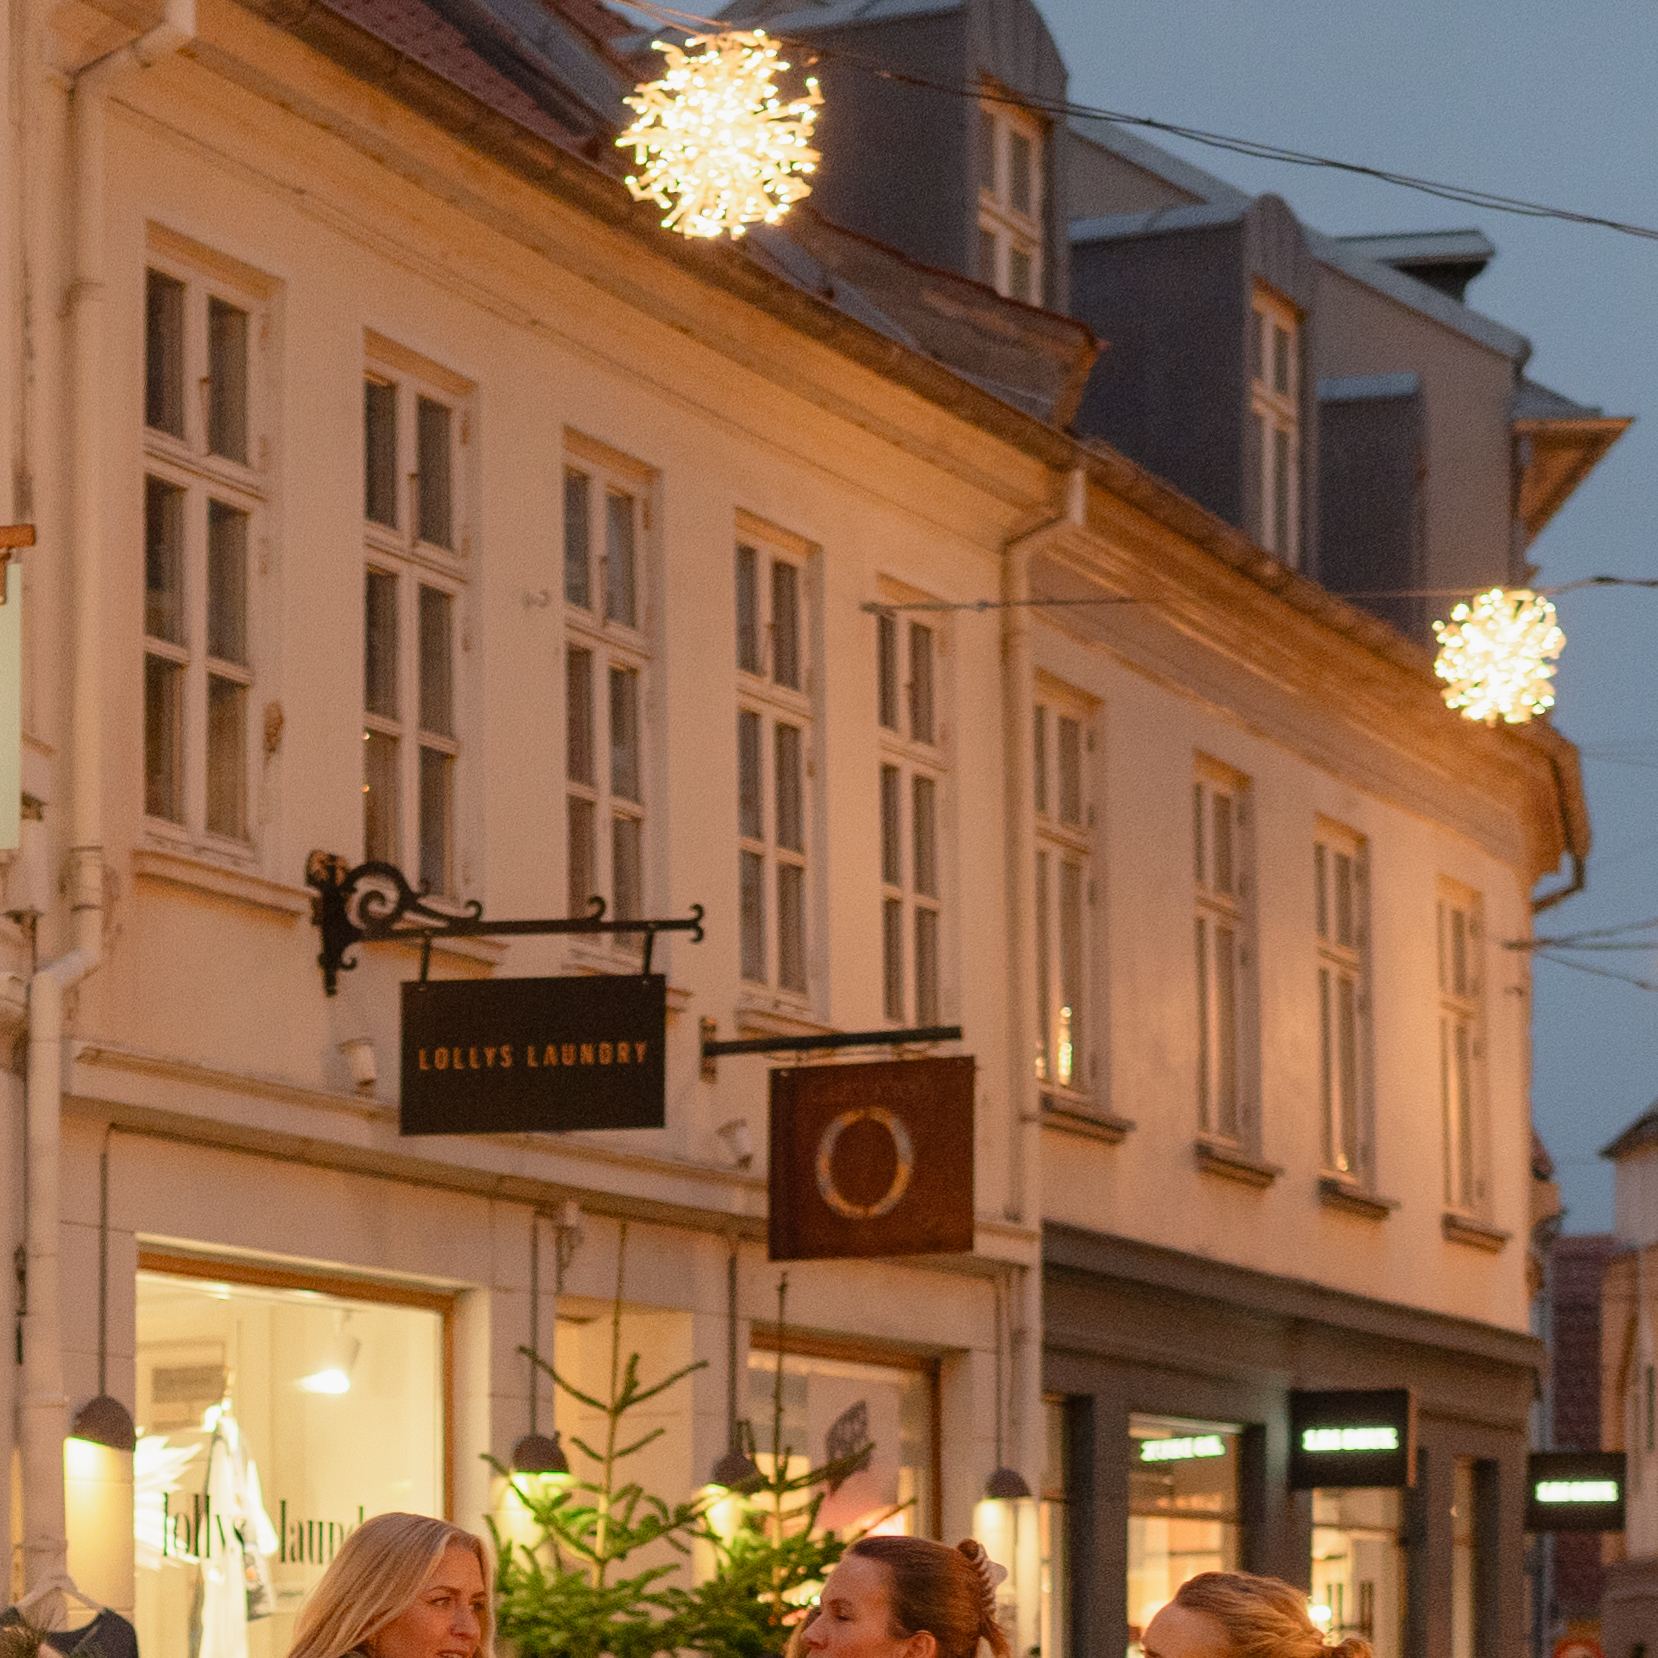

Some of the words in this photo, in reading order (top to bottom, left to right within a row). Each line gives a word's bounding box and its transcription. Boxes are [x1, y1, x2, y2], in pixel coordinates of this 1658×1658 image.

[418, 1043, 513, 1071] LOLLYS
[526, 1040, 648, 1068] LAUNDRY
[279, 1498, 365, 1564] laun
